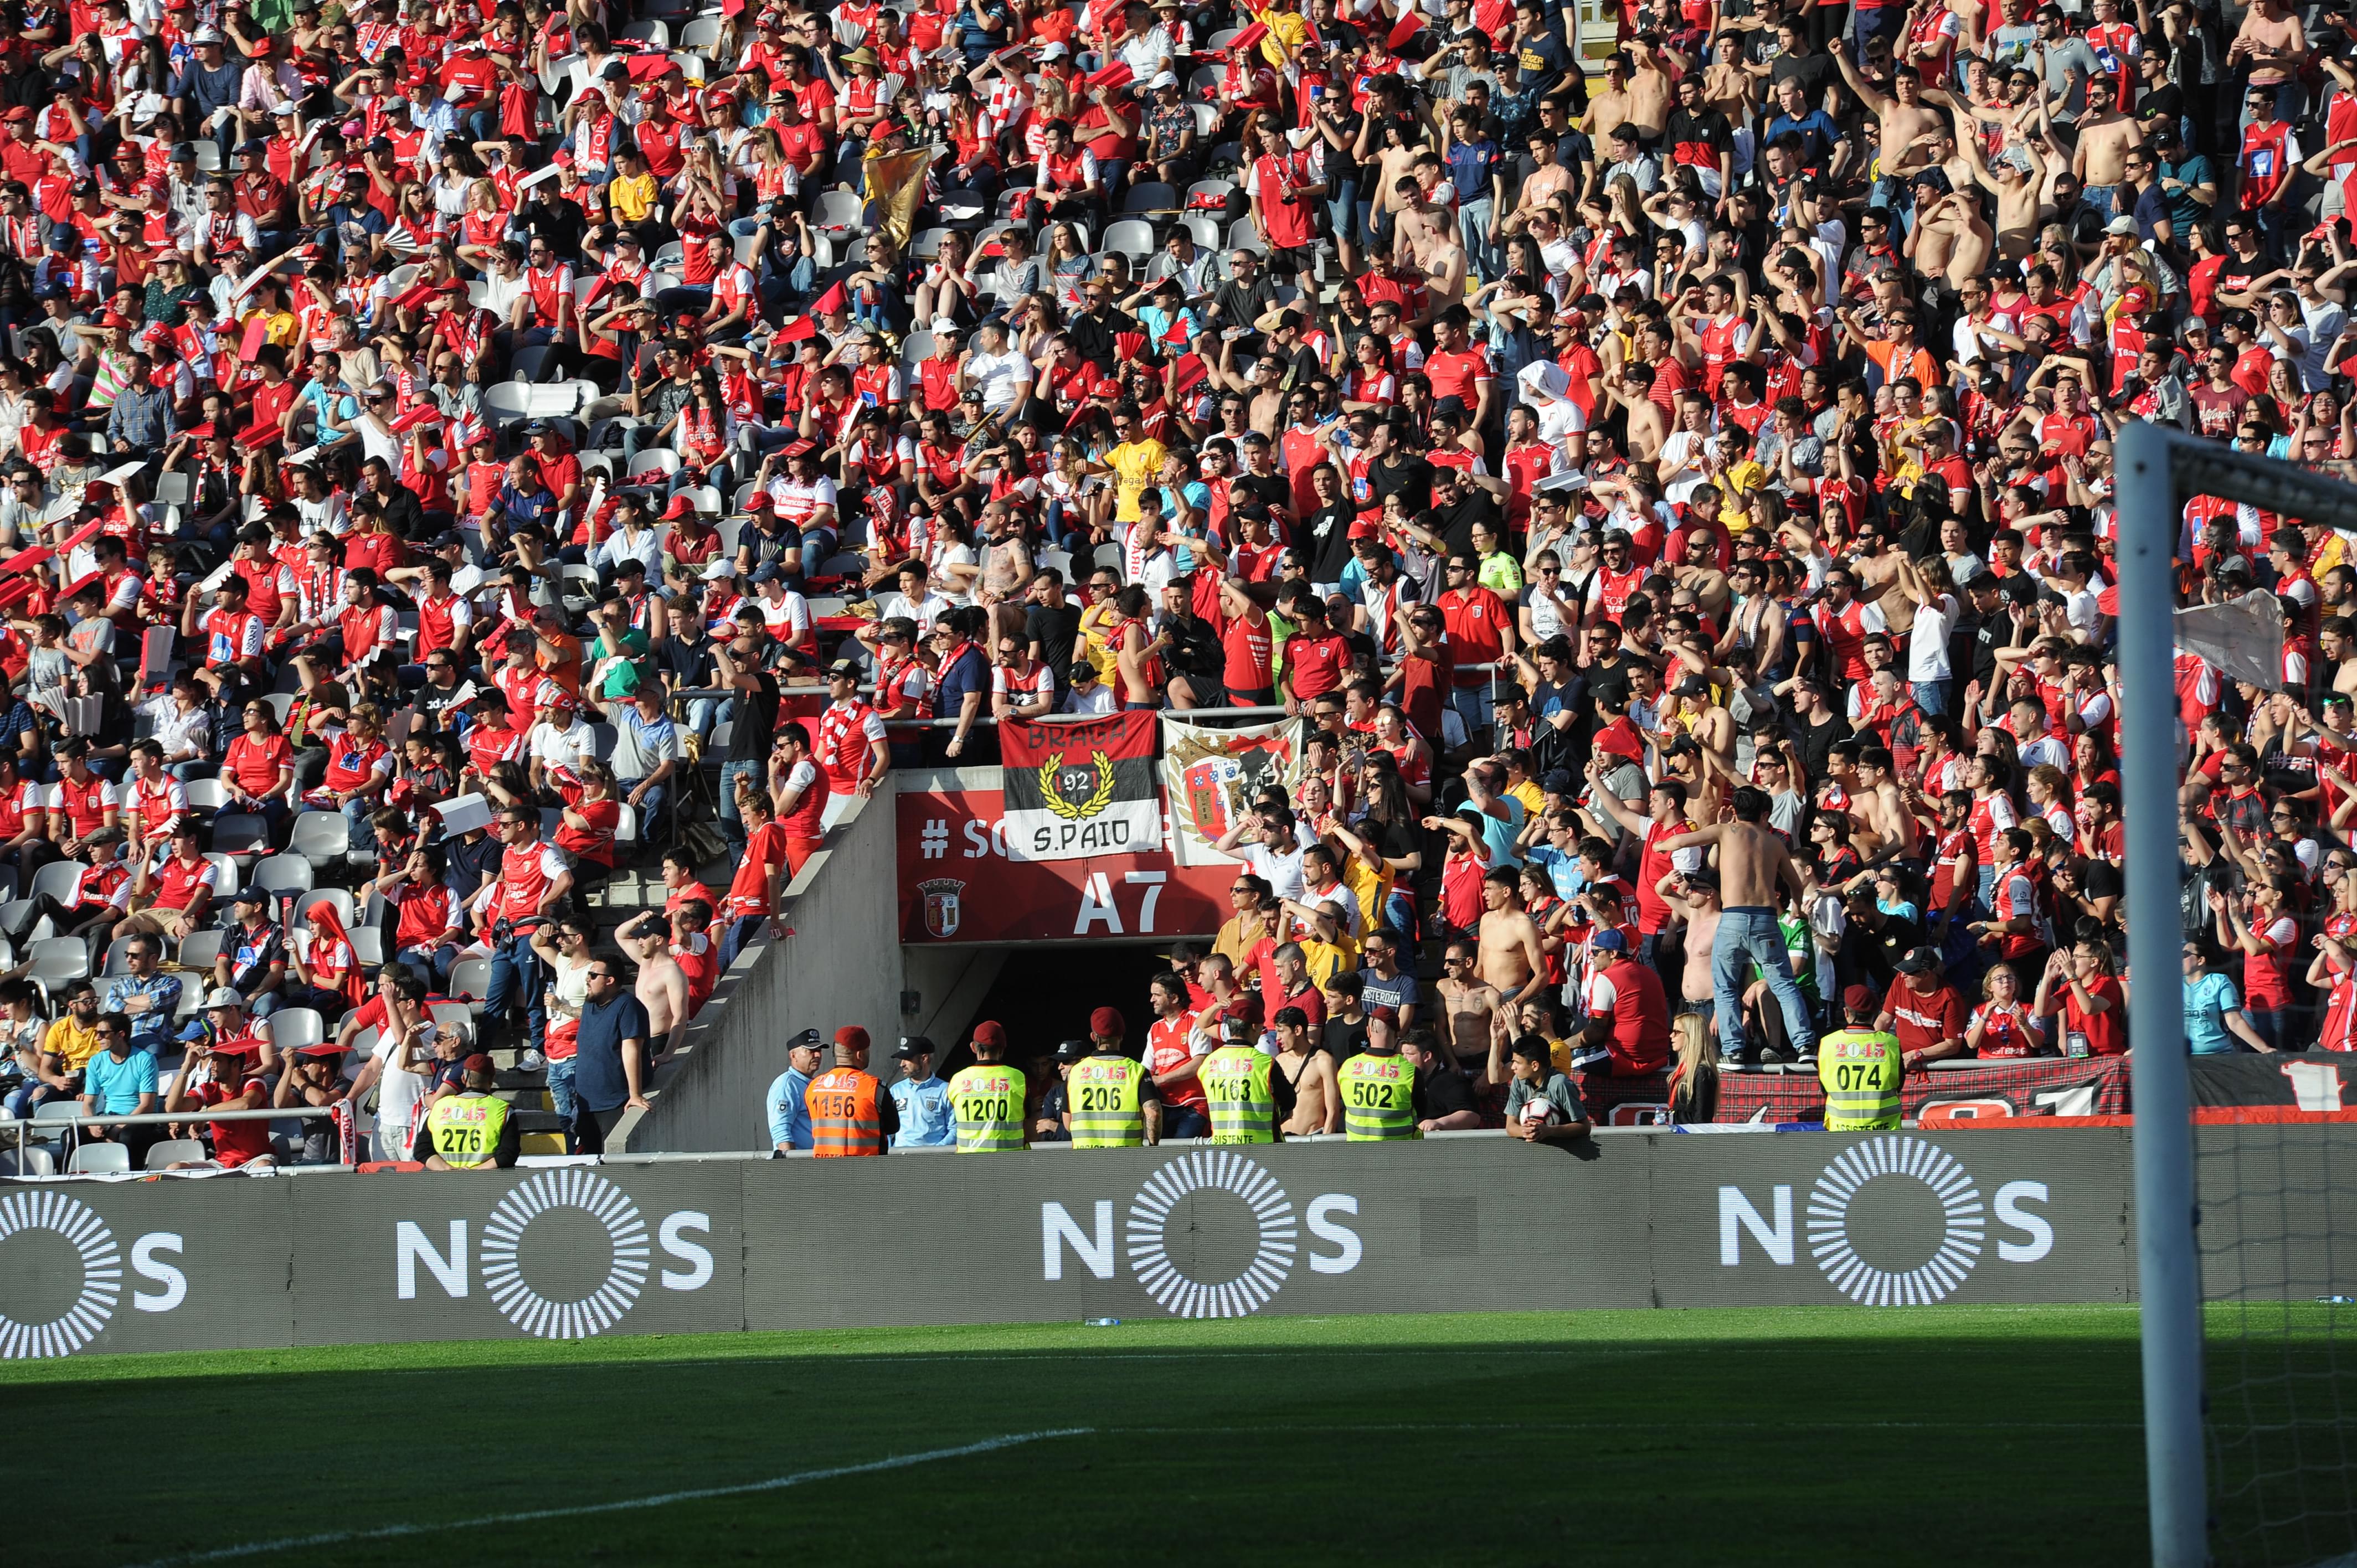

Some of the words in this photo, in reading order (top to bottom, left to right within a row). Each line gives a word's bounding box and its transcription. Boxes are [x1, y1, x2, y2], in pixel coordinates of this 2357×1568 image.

[1521, 54, 1544, 64] LFIGER
[781, 497, 815, 508] BancoBIC
[104, 524, 129, 533] raga
[1604, 596, 1623, 605] FOR
[426, 697, 451, 710] adid
[1028, 719, 1127, 749] BRAGA
[1054, 770, 1099, 792] 1921
[1073, 870, 1167, 935] A7
[1624, 905, 1639, 928] 10
[2184, 1009, 2208, 1019] aga
[1835, 1043, 1886, 1058] 2045
[1080, 1065, 1128, 1081] 2045
[1209, 1057, 1254, 1074] 2045
[1352, 1061, 1401, 1079] 2045
[814, 1074, 860, 1089] 2045
[961, 1076, 1011, 1092] 2045
[1837, 1065, 1882, 1091] 074
[1080, 1087, 1121, 1111] 206
[1210, 1079, 1251, 1101] 1163
[1352, 1082, 1393, 1108] 502
[440, 1106, 488, 1121] 2045
[812, 1095, 855, 1118] 1156
[961, 1098, 1008, 1121] 1200
[441, 1128, 481, 1153] 276
[1719, 1136, 2054, 1306] NOS
[1042, 1151, 1362, 1318] NOS
[397, 1169, 714, 1339] NOS
